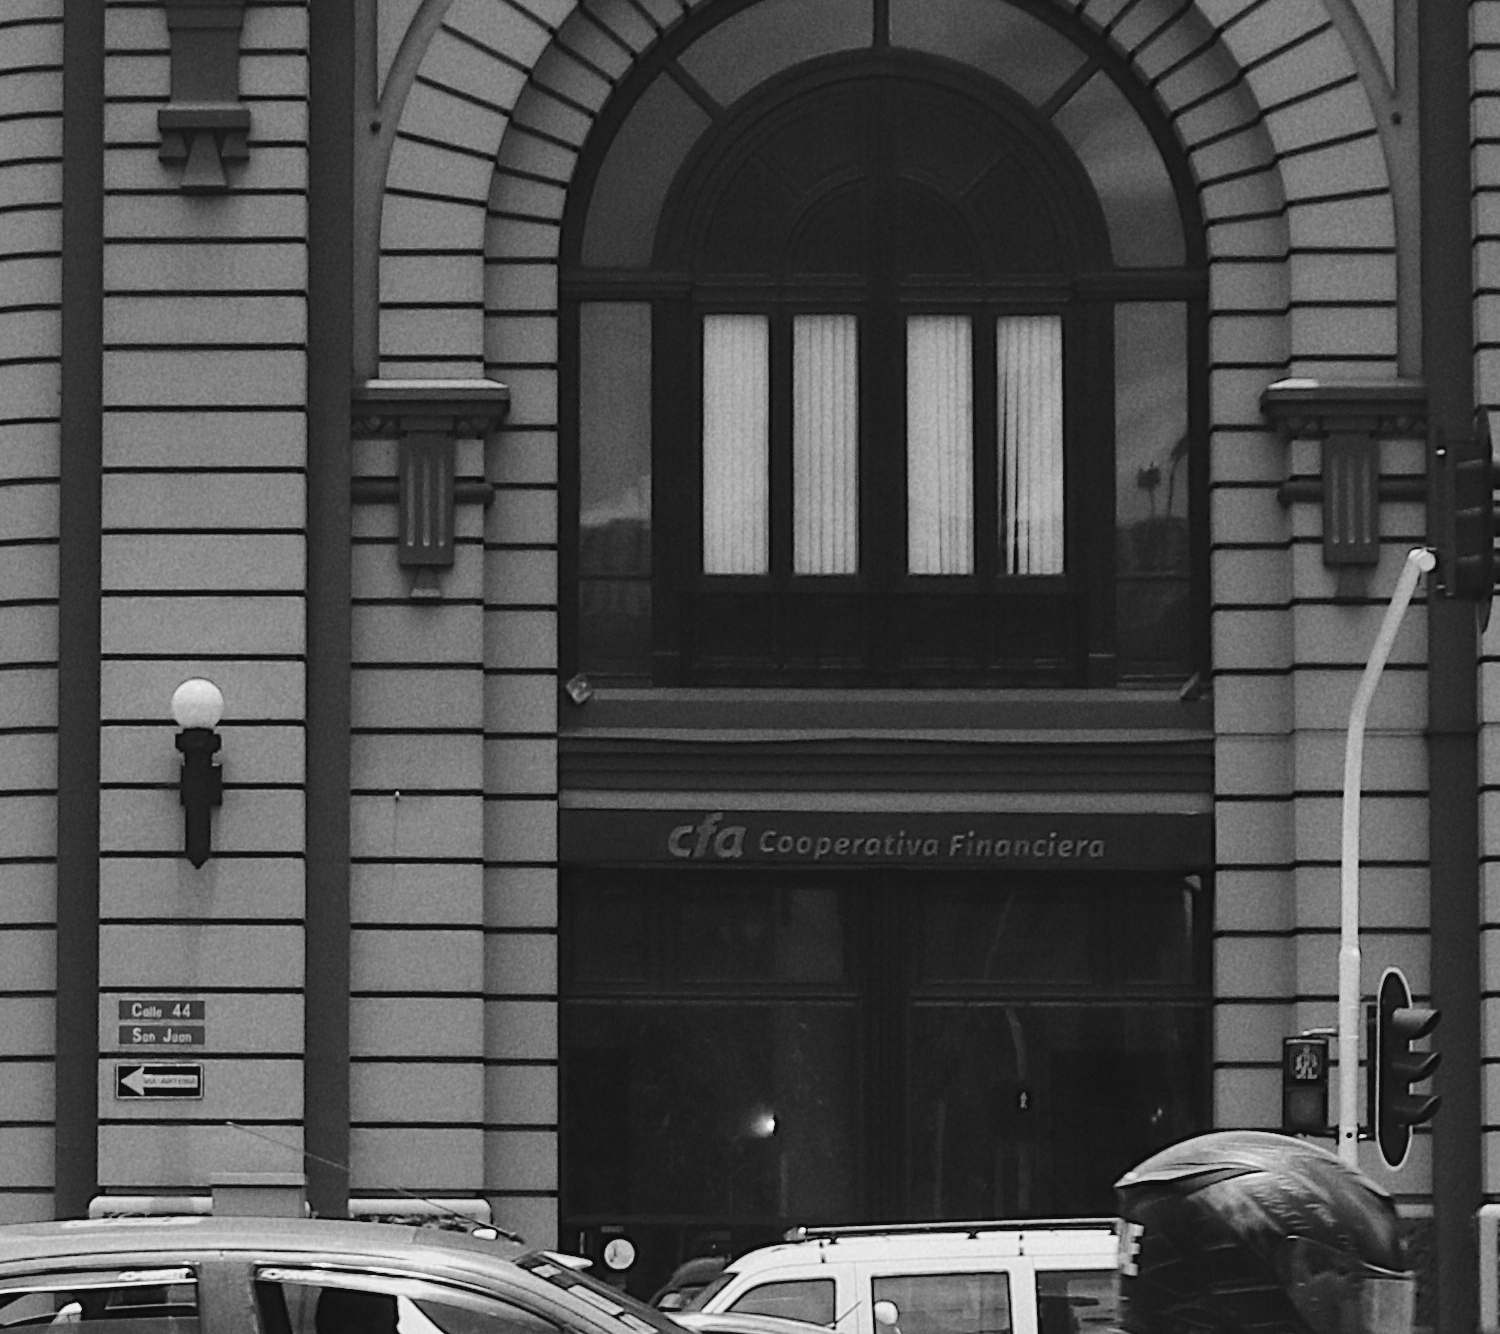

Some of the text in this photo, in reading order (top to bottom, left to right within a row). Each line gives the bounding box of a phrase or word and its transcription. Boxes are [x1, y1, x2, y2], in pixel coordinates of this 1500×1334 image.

[667, 811, 1106, 860] cfa Cooperativa Financiera
[132, 1002, 191, 1018] Calle 44
[132, 1027, 192, 1043] San Juan
